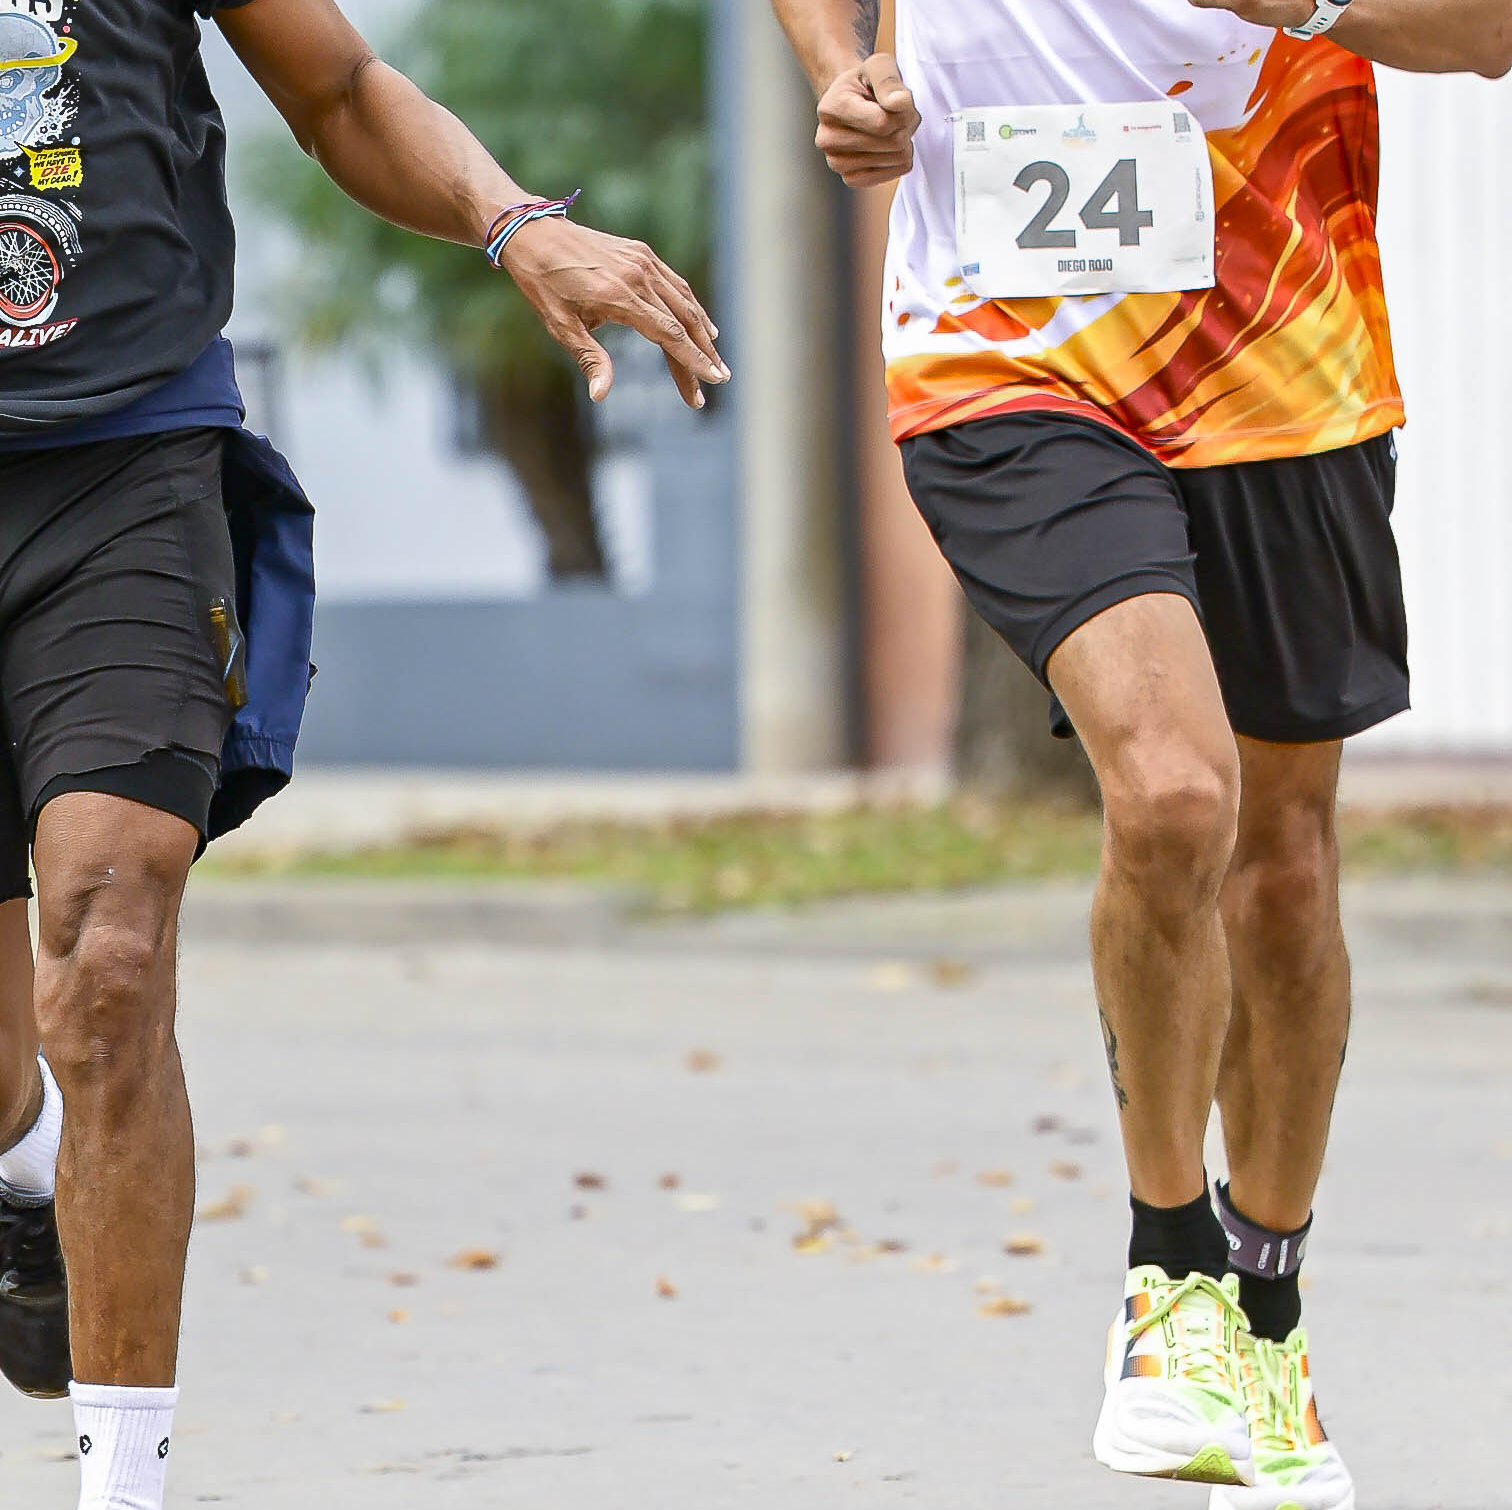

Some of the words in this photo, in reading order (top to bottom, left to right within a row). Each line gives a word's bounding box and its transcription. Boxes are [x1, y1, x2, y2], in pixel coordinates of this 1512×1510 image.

[67, 156, 77, 164] TO
[40, 164, 71, 177] DIE
[1012, 158, 1153, 249] 24
[1057, 259, 1086, 272] DIEGO
[1088, 258, 1113, 272] ROJO
